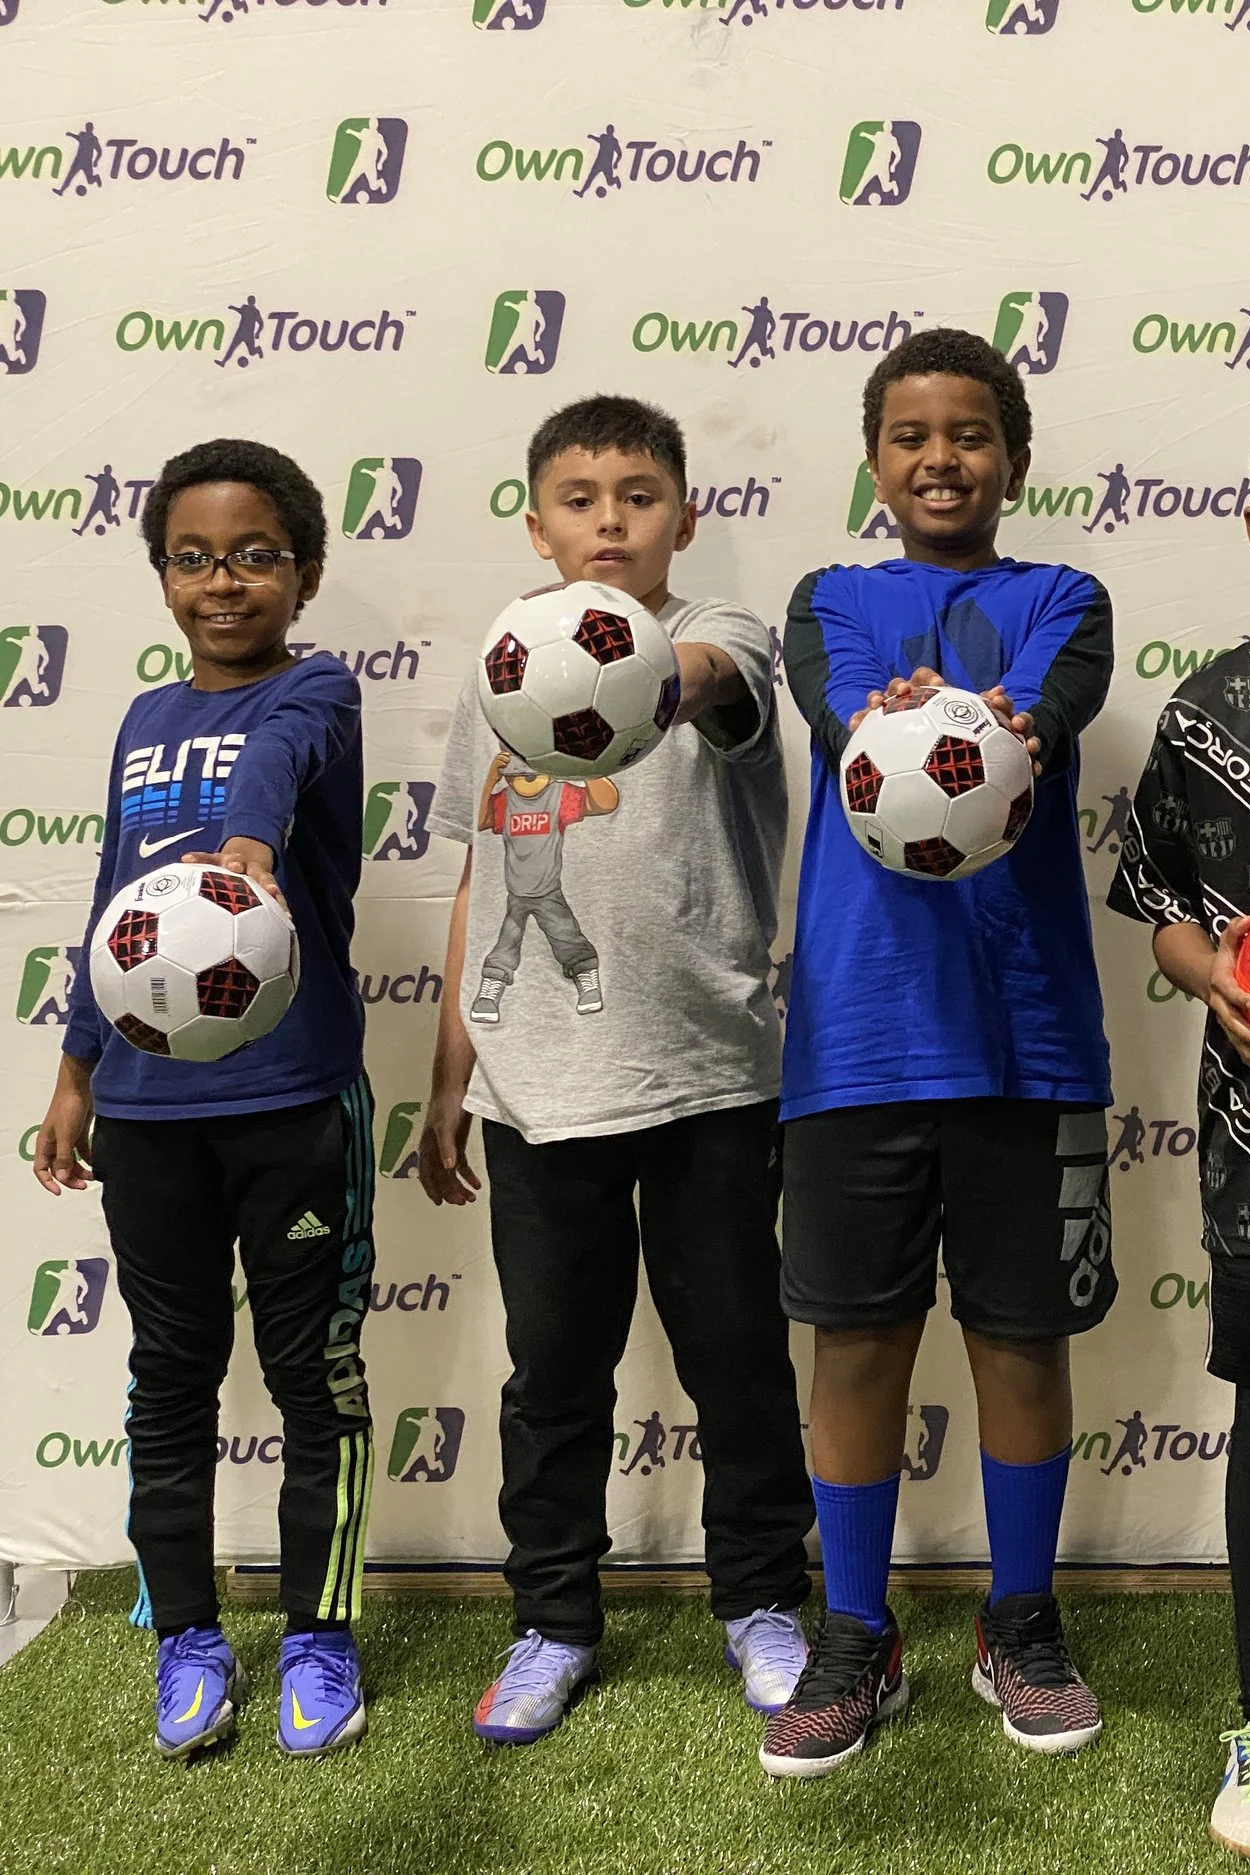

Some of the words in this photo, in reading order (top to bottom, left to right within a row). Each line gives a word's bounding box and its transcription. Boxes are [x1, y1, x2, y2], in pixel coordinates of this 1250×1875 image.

[0, 146, 62, 179] wn
[477, 140, 583, 182] Own
[987, 143, 1092, 186] Own
[115, 311, 223, 352] Own
[632, 311, 737, 352] Own
[1132, 313, 1236, 354] Own
[1136, 641, 1233, 679] Ow
[122, 733, 247, 794] ELITE
[511, 813, 551, 833] DRIP
[360, 966, 443, 1004] uch
[287, 1225, 331, 1241] adidas
[1150, 1424, 1232, 1462] Tou
